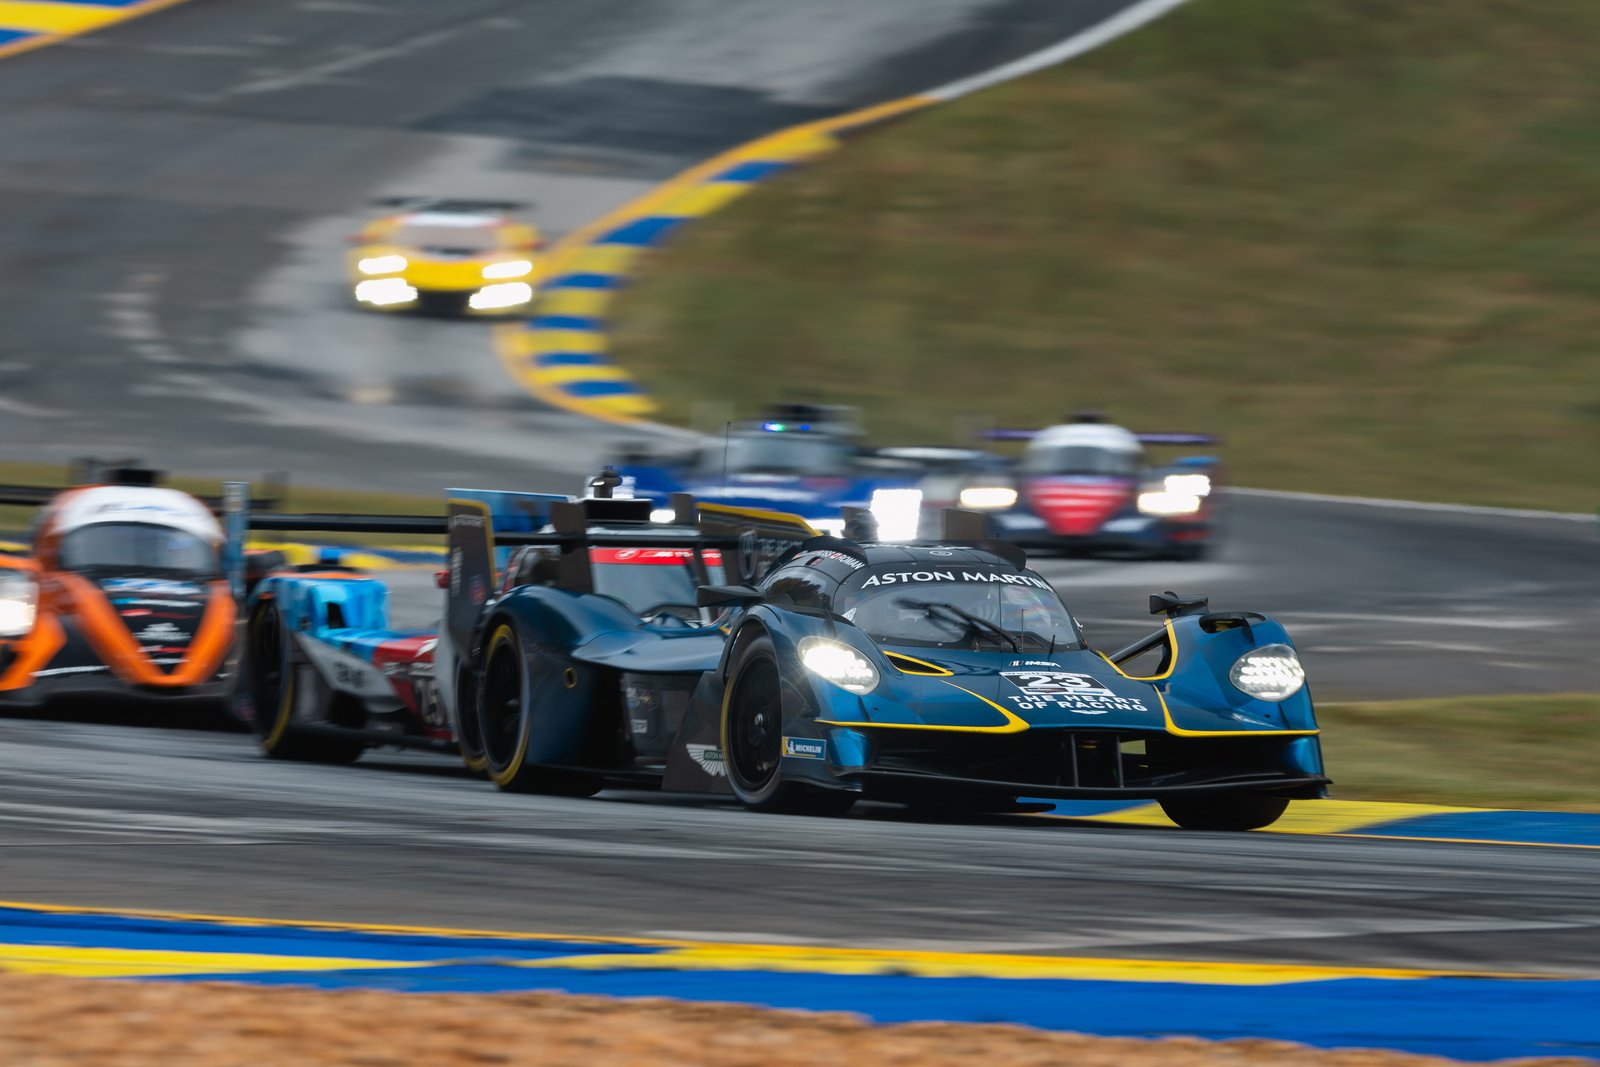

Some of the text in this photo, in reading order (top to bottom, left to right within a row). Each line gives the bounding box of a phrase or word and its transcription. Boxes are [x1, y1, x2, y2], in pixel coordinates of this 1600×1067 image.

[861, 571, 1054, 593] ASTON MARTIN
[1024, 660, 1062, 668] IMSA
[1019, 674, 1092, 688] 23
[1008, 694, 1142, 705] THE HEART
[1017, 701, 1149, 712] OF RACING
[795, 743, 822, 754] MICHELIN
